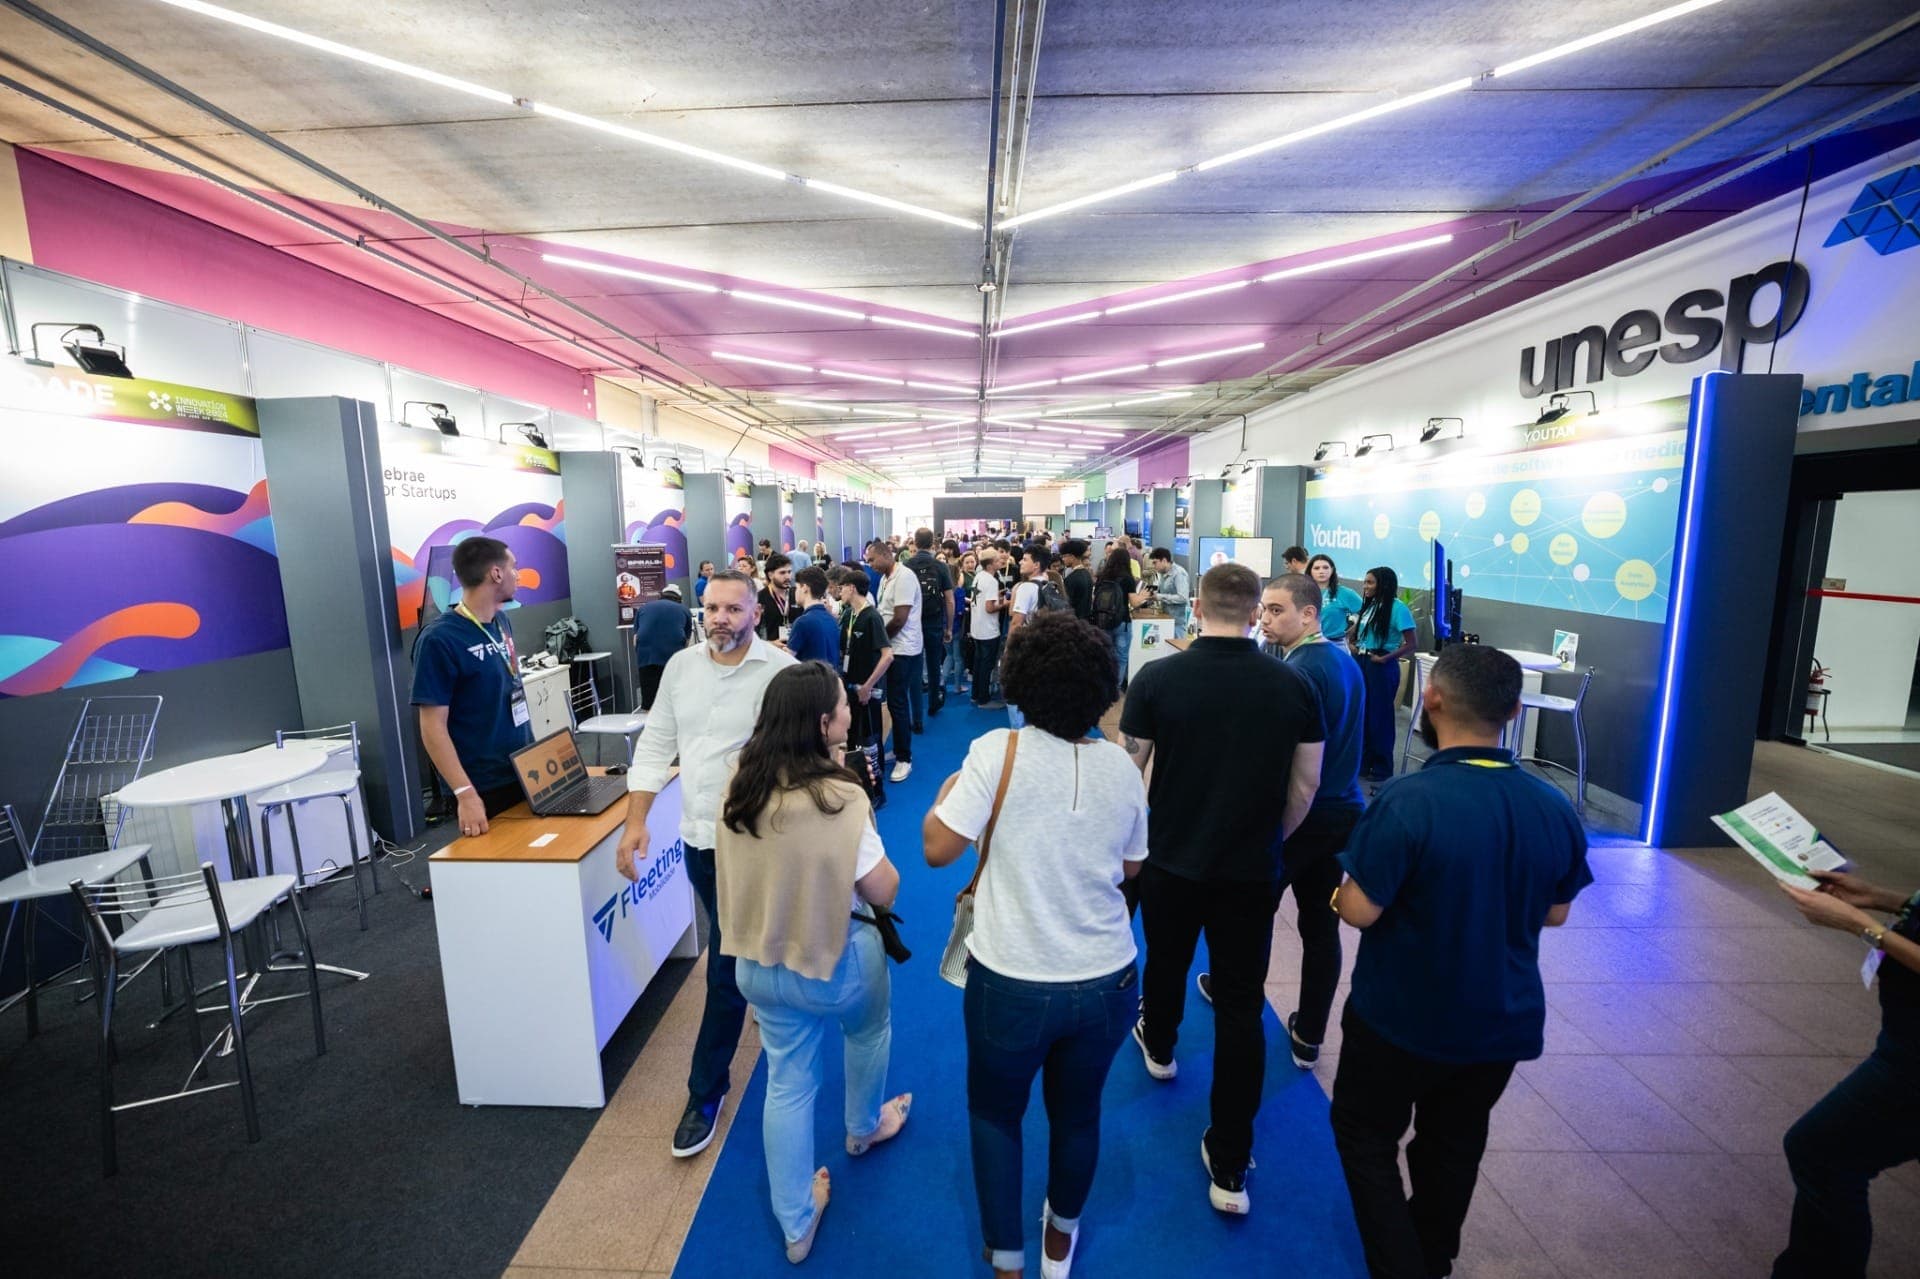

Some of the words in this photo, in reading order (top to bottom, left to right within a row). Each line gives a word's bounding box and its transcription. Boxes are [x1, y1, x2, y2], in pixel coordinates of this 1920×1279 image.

[1519, 259, 1811, 399] unesp
[1523, 424, 1576, 442] YOUTAN
[401, 483, 457, 501] Startups
[1310, 523, 1361, 550] Youtan
[620, 838, 683, 919] Fleeting
